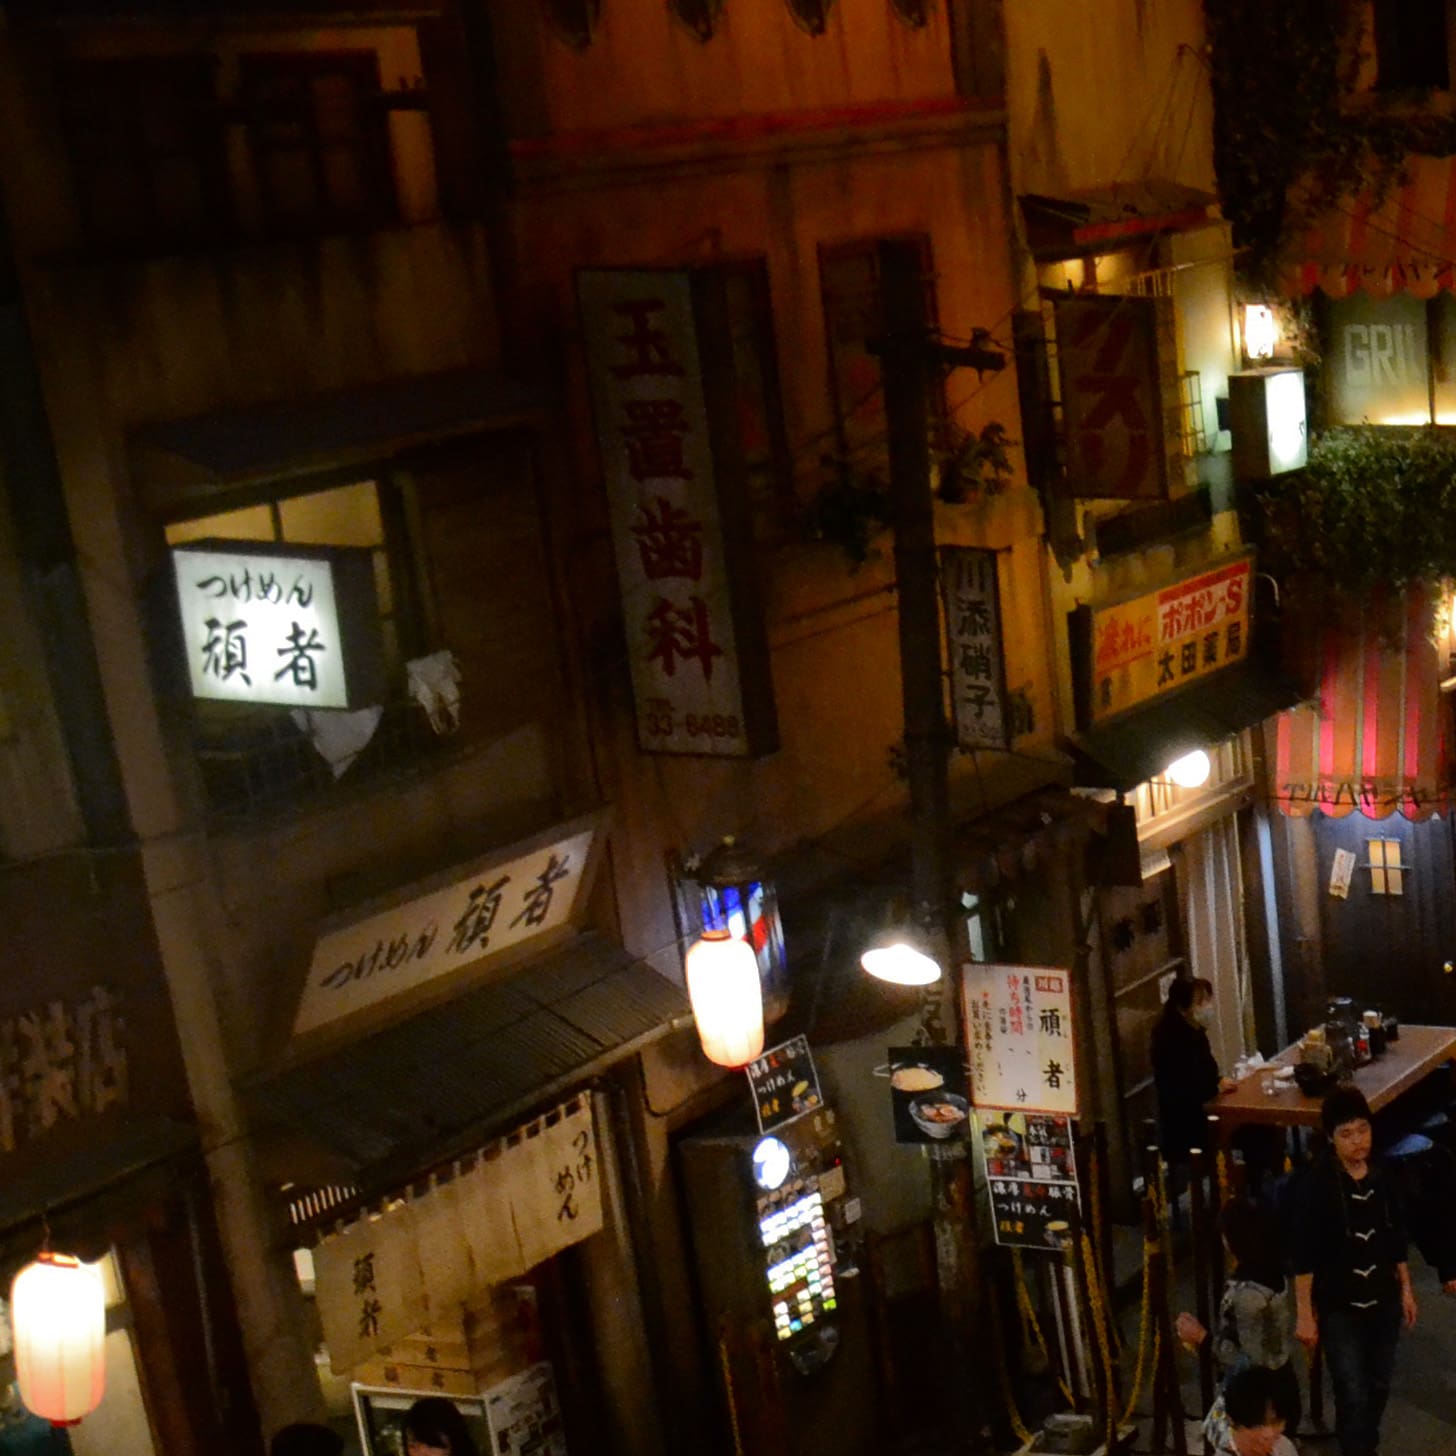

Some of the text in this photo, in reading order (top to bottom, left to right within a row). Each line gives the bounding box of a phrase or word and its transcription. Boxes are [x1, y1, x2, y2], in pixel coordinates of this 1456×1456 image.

[609, 299, 722, 680] 玉置歯科
[197, 574, 312, 609] つけめん
[202, 619, 326, 691] 頑者
[319, 855, 570, 991] つけめん 頑者
[1039, 1007, 1064, 1090] 頑者
